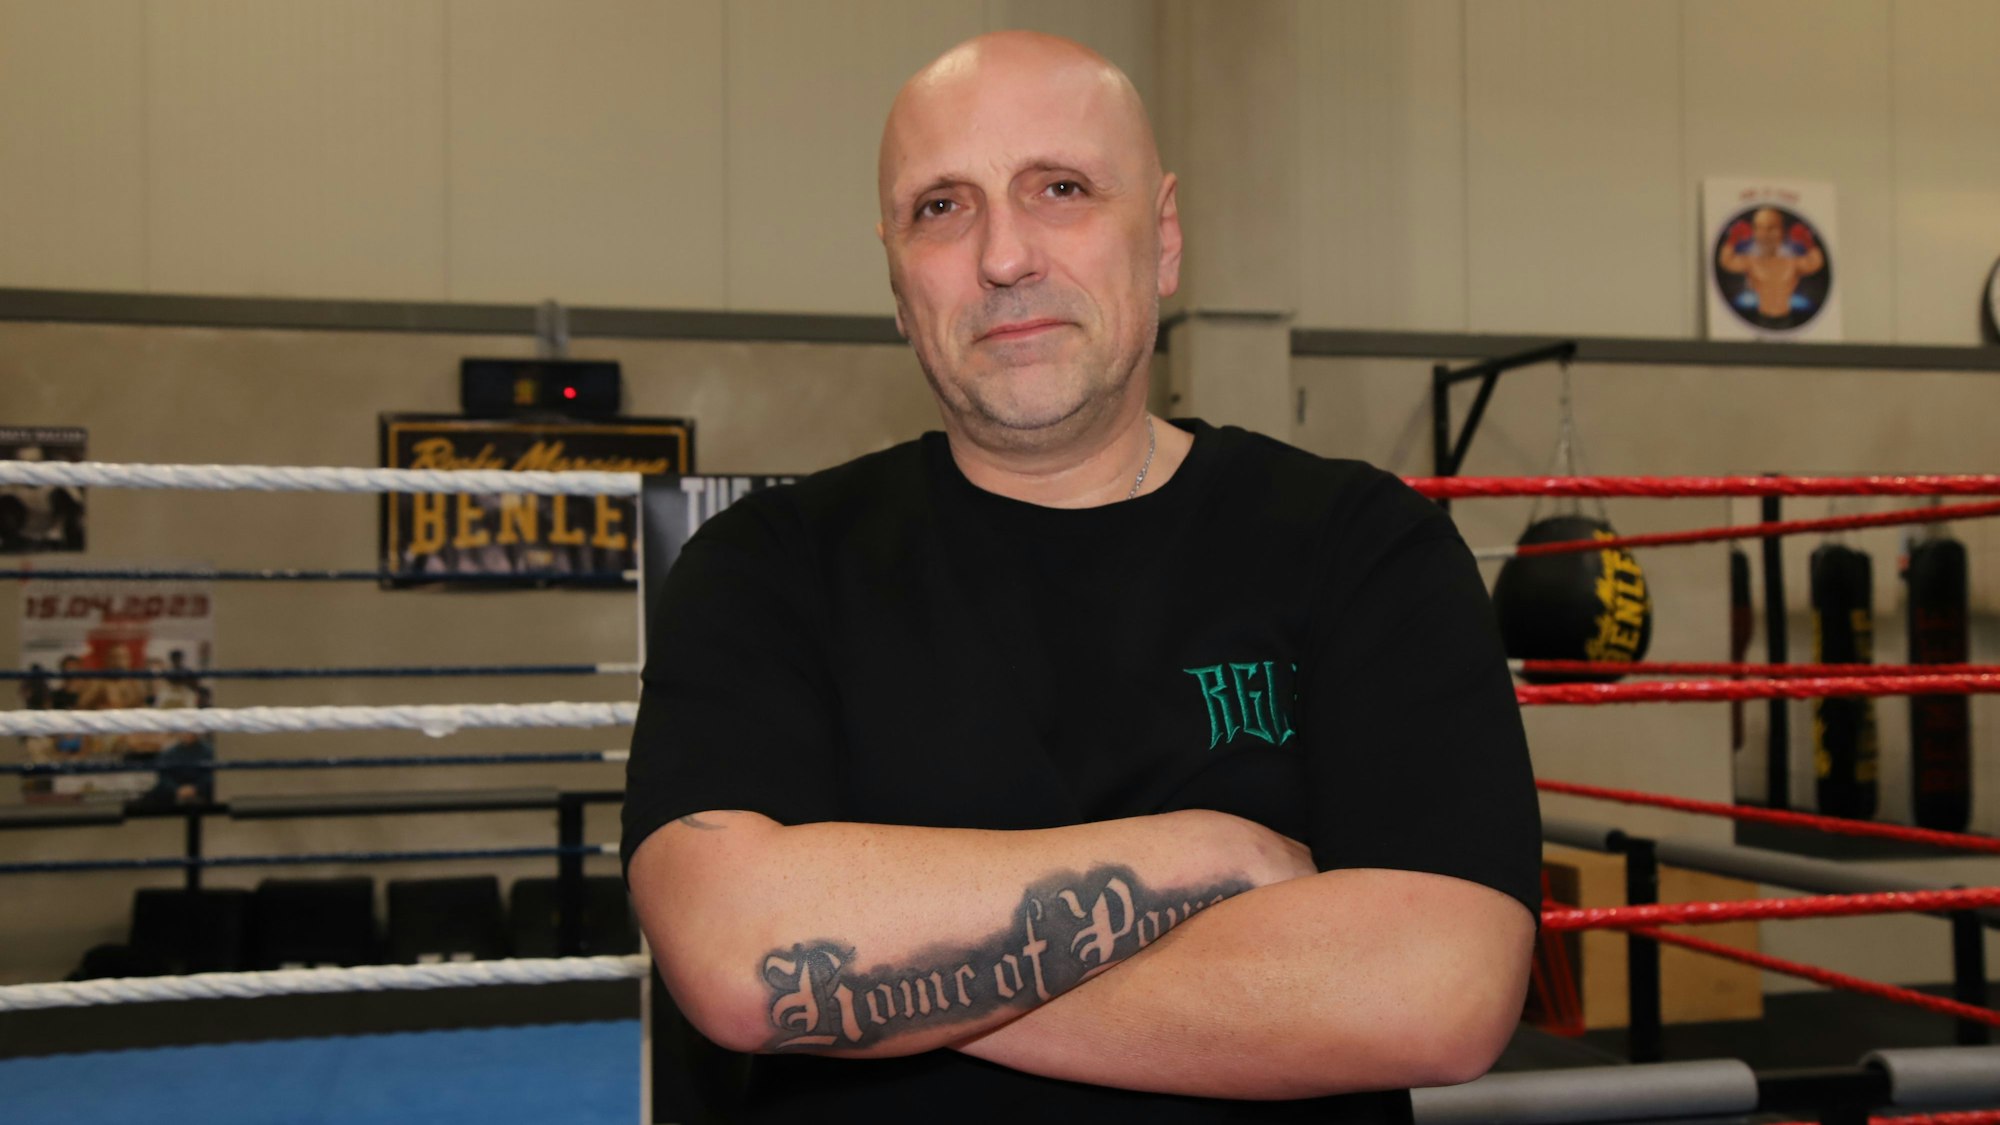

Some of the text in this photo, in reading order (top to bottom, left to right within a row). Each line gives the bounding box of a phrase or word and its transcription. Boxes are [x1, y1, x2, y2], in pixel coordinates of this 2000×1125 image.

[408, 489, 641, 556] BENLE
[25, 594, 210, 621] 15.04.2023
[1183, 661, 1297, 750] RGL
[993, 898, 1050, 1001] of
